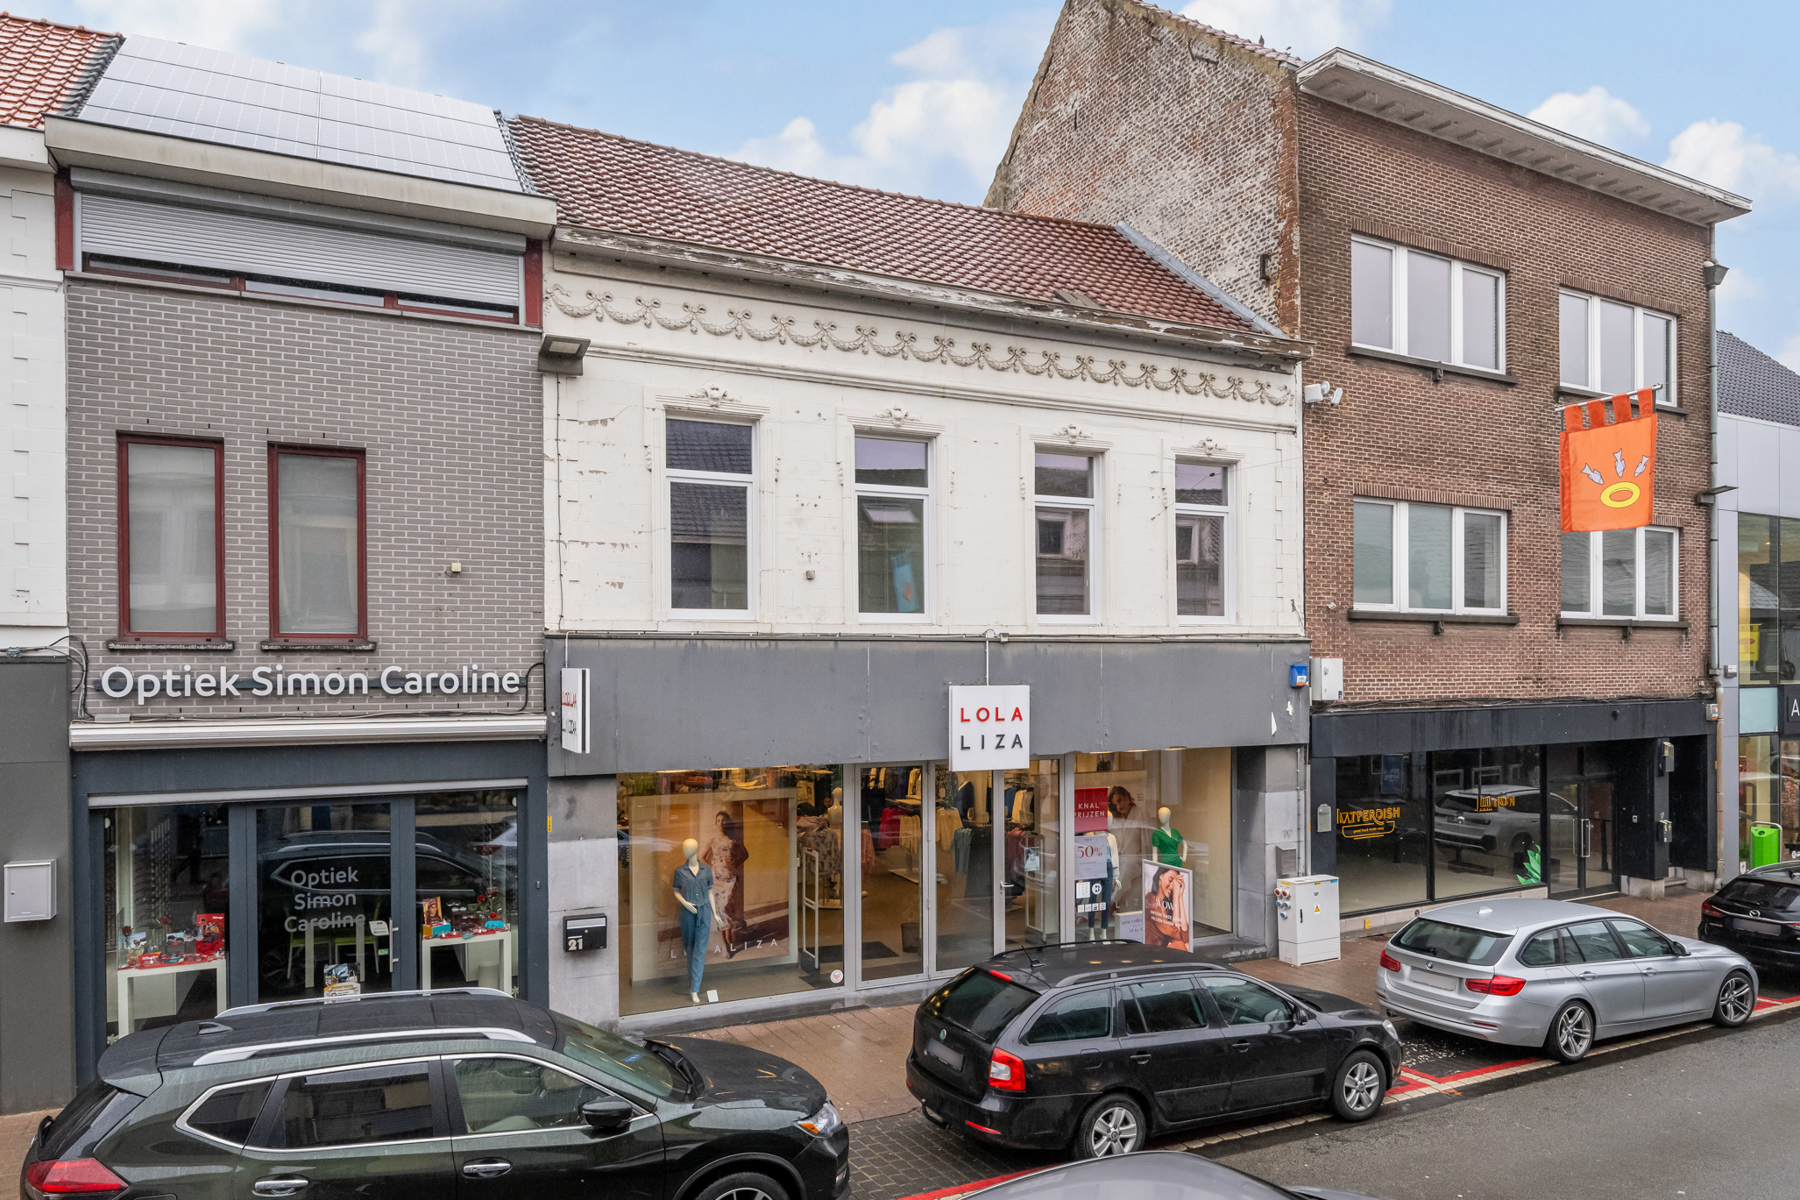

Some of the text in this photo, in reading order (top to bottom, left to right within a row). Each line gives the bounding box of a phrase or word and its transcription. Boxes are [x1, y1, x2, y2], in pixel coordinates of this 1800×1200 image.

[101, 663, 520, 705] Optiek Simon Caroline
[960, 706, 1023, 723] LOLA
[960, 733, 1023, 751] LIZA
[1078, 802, 1100, 810] KNAL
[1077, 845, 1103, 859] 50%
[290, 866, 359, 889] Optiek
[294, 892, 357, 910] Simon
[284, 911, 366, 933] Caroline
[568, 938, 583, 950] 21
[670, 938, 778, 959] LALIZA
